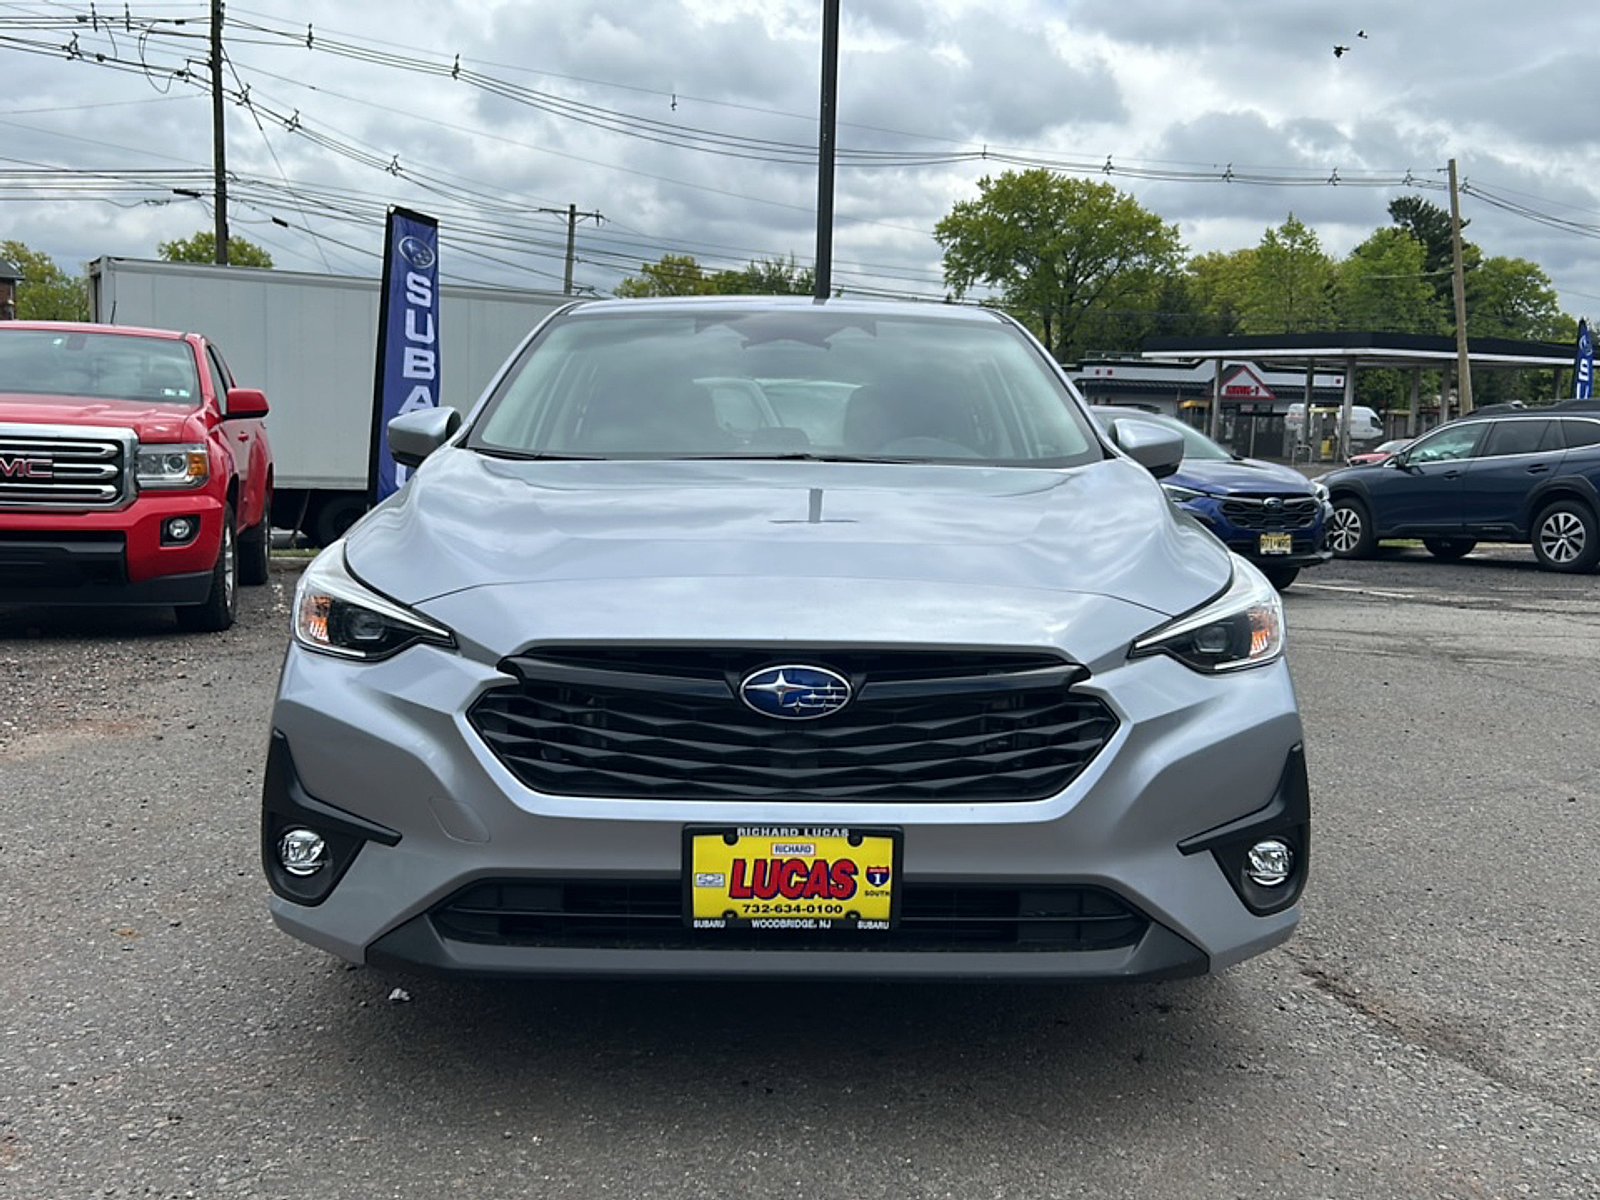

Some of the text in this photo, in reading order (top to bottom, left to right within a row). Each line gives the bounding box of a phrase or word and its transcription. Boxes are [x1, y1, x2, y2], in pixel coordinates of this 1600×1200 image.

[395, 271, 436, 488] SUBA
[0, 457, 53, 478] MC
[736, 827, 850, 838] RICHARD LUCAS
[774, 845, 811, 854] RICHARD
[728, 858, 860, 900] LUCAS
[873, 873, 881, 885] 1
[742, 904, 844, 914] 732-634-0100
[693, 919, 726, 929] SUBARU
[818, 919, 832, 930] NJ
[857, 921, 890, 930] SUBARU
